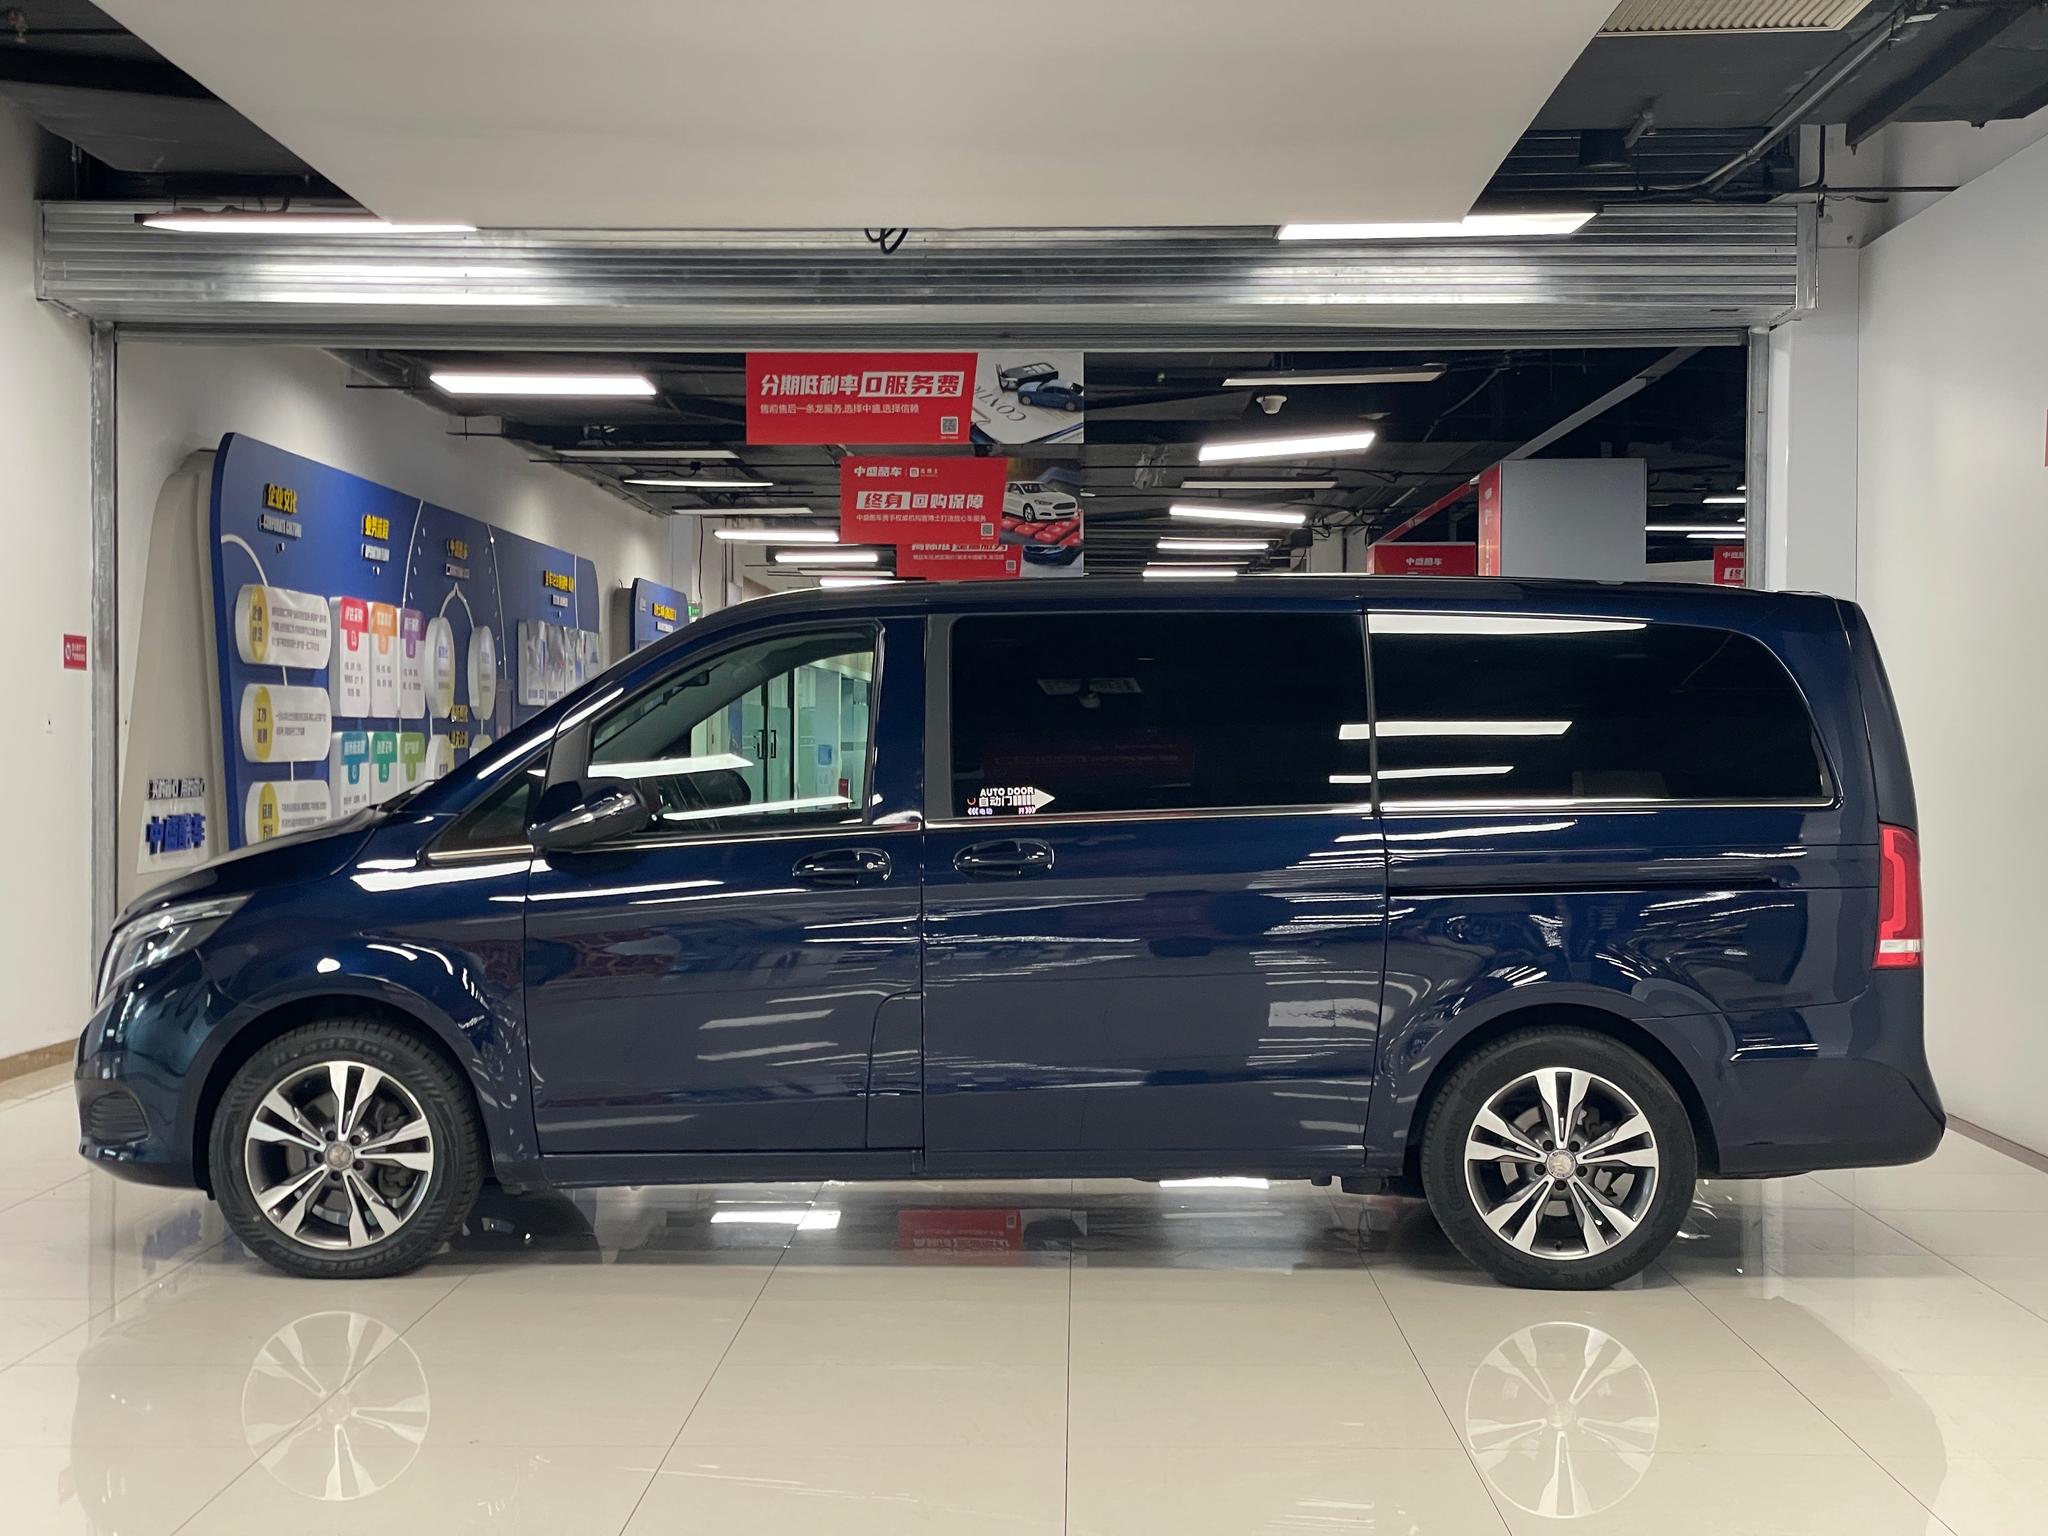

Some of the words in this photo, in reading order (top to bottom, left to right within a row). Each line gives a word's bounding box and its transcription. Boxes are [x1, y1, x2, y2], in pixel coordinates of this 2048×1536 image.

[980, 787, 1005, 797] AUTO
[1007, 786, 1034, 795] DOOR
[979, 796, 1012, 807] 自动门
